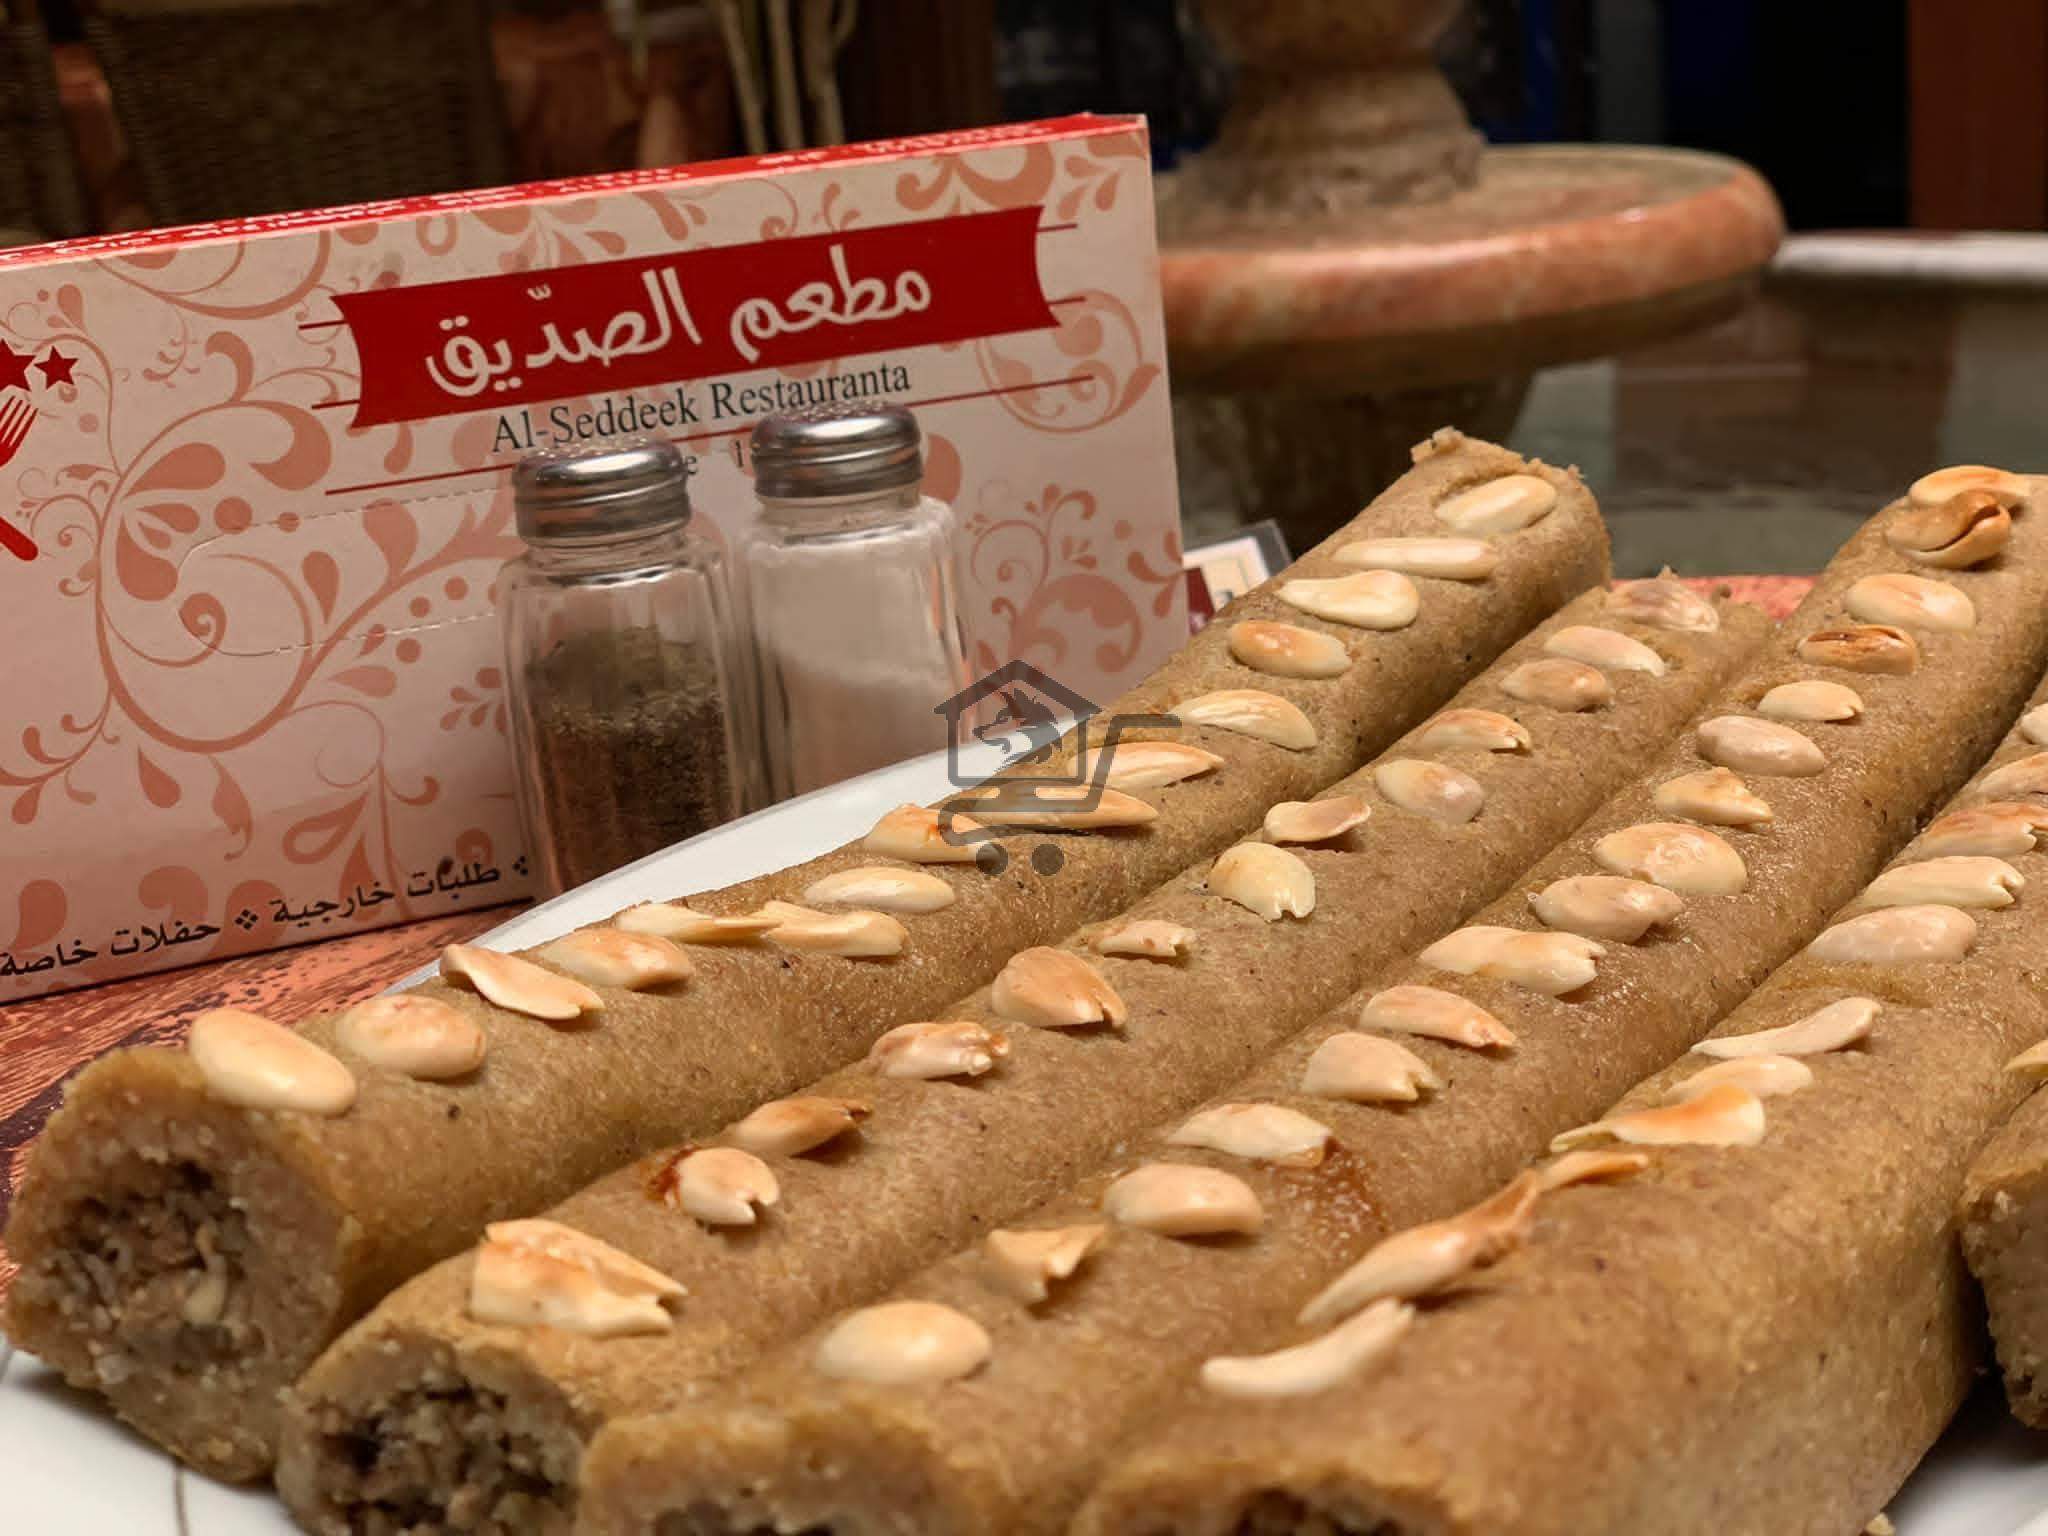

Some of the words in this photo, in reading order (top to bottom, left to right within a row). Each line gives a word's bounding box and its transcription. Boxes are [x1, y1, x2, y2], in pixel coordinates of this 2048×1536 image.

[730, 243, 931, 364] مطعم
[492, 387, 699, 453] Al-Seddeek
[709, 363, 911, 419] Restauranta
[407, 860, 500, 899] طلبات
[269, 881, 395, 927] خارجية
[0, 939, 98, 977] خاصة
[110, 920, 220, 956] حفلات
